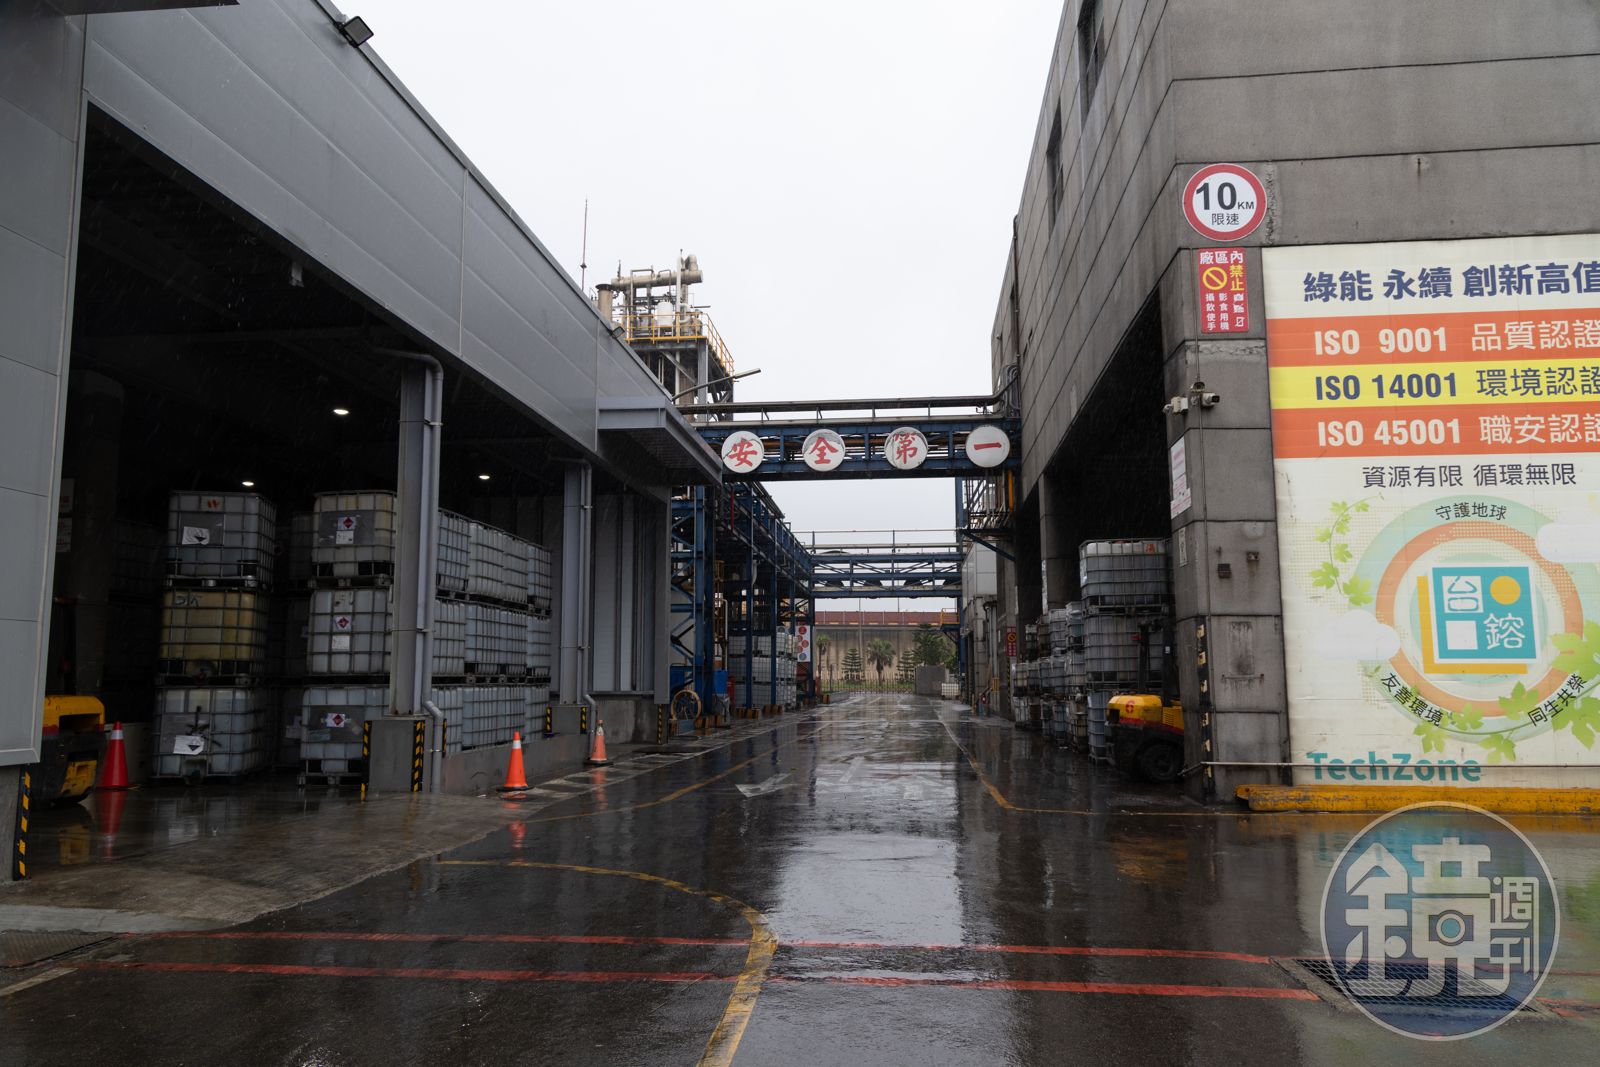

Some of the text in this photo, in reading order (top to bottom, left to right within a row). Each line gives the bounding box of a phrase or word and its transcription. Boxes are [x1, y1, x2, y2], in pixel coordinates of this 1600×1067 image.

[1211, 213, 1240, 226] 限速
[1199, 250, 1244, 265] 廠區內
[1229, 264, 1245, 291] 禁止
[1303, 260, 1600, 303] 綠能 永續 創新高值
[1314, 319, 1600, 356] ISO 9001 品質認證
[1315, 375, 1361, 401] ISO
[1371, 372, 1457, 400] 14001
[1318, 420, 1364, 447] ISO
[1373, 418, 1461, 446] 45001
[1362, 462, 1577, 488] 資源有限 循環無限
[1435, 502, 1508, 522] 守護地球
[1380, 672, 1444, 727] 友善環境
[1527, 674, 1588, 727] 同生共榮
[1307, 751, 1482, 782] TechZone
